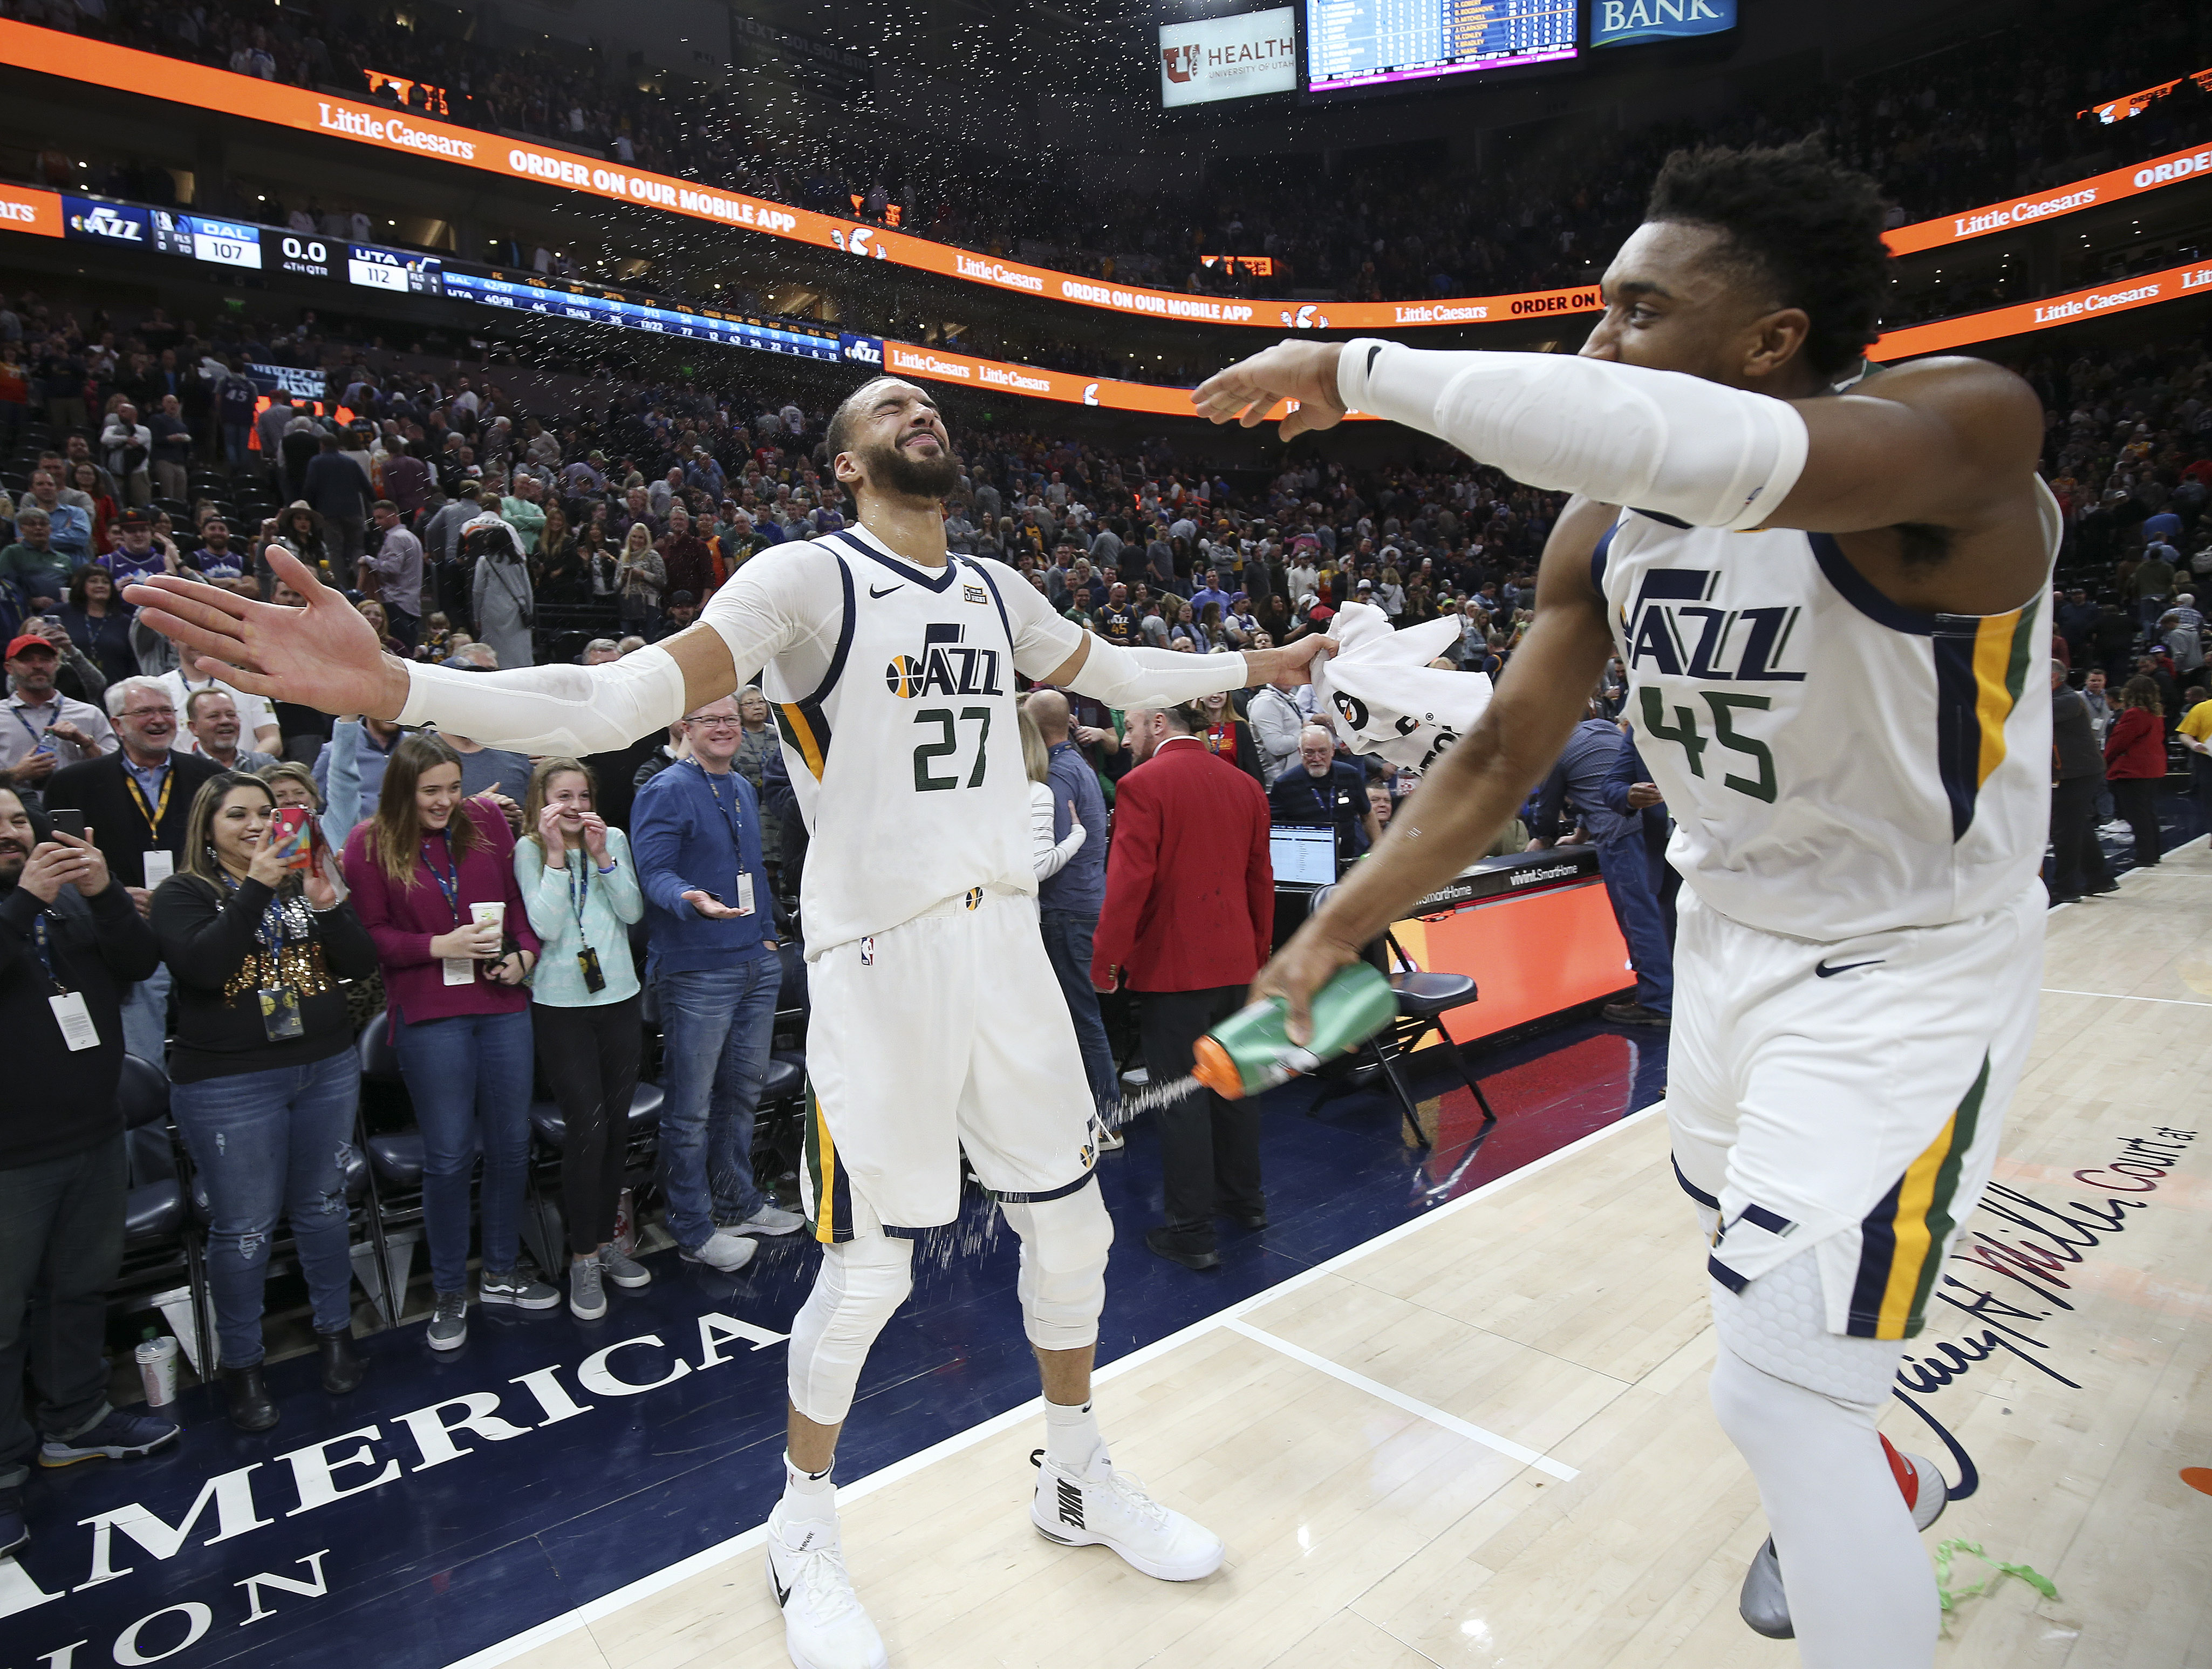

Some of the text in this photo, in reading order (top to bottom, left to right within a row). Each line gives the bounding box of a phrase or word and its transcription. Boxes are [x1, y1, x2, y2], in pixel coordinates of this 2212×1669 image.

[734, 15, 777, 42] TEXT
[1601, 0, 1720, 32] BANK
[1209, 37, 1294, 66] HEALTH
[1209, 65, 1255, 78] UNIVERSITY
[1273, 60, 1295, 70] UTAH
[319, 103, 1596, 323] Little Caesars ORDER ON OUR MOBILE APP Little Caesars ORDER ON OUR MOBILE APP Little Caesars ORDER ON
[1954, 210, 2011, 237] Little
[2011, 188, 2097, 222] Caesars
[203, 222, 250, 240] DAL
[213, 242, 242, 259] 107
[282, 237, 327, 263] 0.0
[355, 248, 399, 265] UTA
[367, 268, 389, 283] 112
[446, 275, 472, 285] DAL
[483, 281, 513, 292] 42/97
[447, 289, 474, 299] UTA
[484, 294, 514, 307] 40/91
[681, 327, 693, 336] 77
[2035, 301, 2083, 324] Little
[2084, 284, 2160, 312] Caesars
[892, 349, 1050, 392] Little Caesars Little Caesars
[1111, 623, 1128, 635] 45
[1624, 568, 1807, 681] JAZZ
[886, 623, 1003, 699] JAZZ
[913, 707, 991, 792] 27
[1640, 686, 1777, 804] 45
[2073, 1136, 2188, 1193] Court
[2151, 1126, 2199, 1142] at
[1057, 1477, 1087, 1530] NIKE
